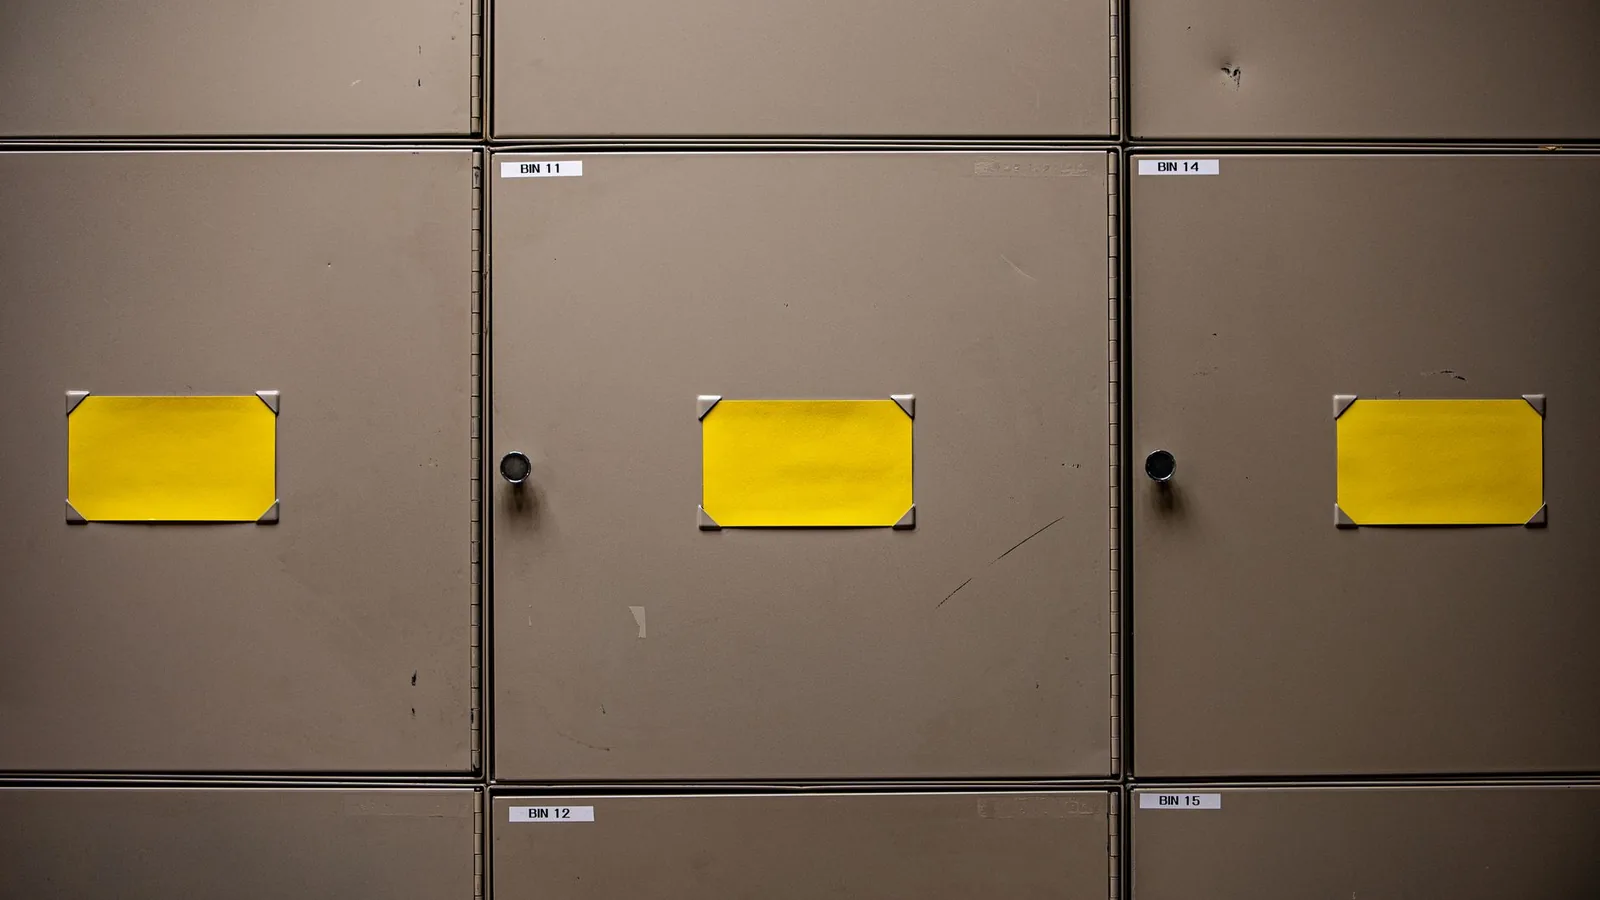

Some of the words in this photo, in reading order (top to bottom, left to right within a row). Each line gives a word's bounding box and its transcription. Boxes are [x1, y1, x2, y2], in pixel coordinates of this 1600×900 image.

[520, 163, 541, 174] BIN
[547, 163, 560, 174] 11
[1157, 161, 1178, 172] BIN
[1183, 161, 1199, 172] 14
[1159, 795, 1179, 806] BIN
[1184, 795, 1201, 806] 15
[528, 808, 549, 819] BIN
[554, 808, 571, 819] 12
